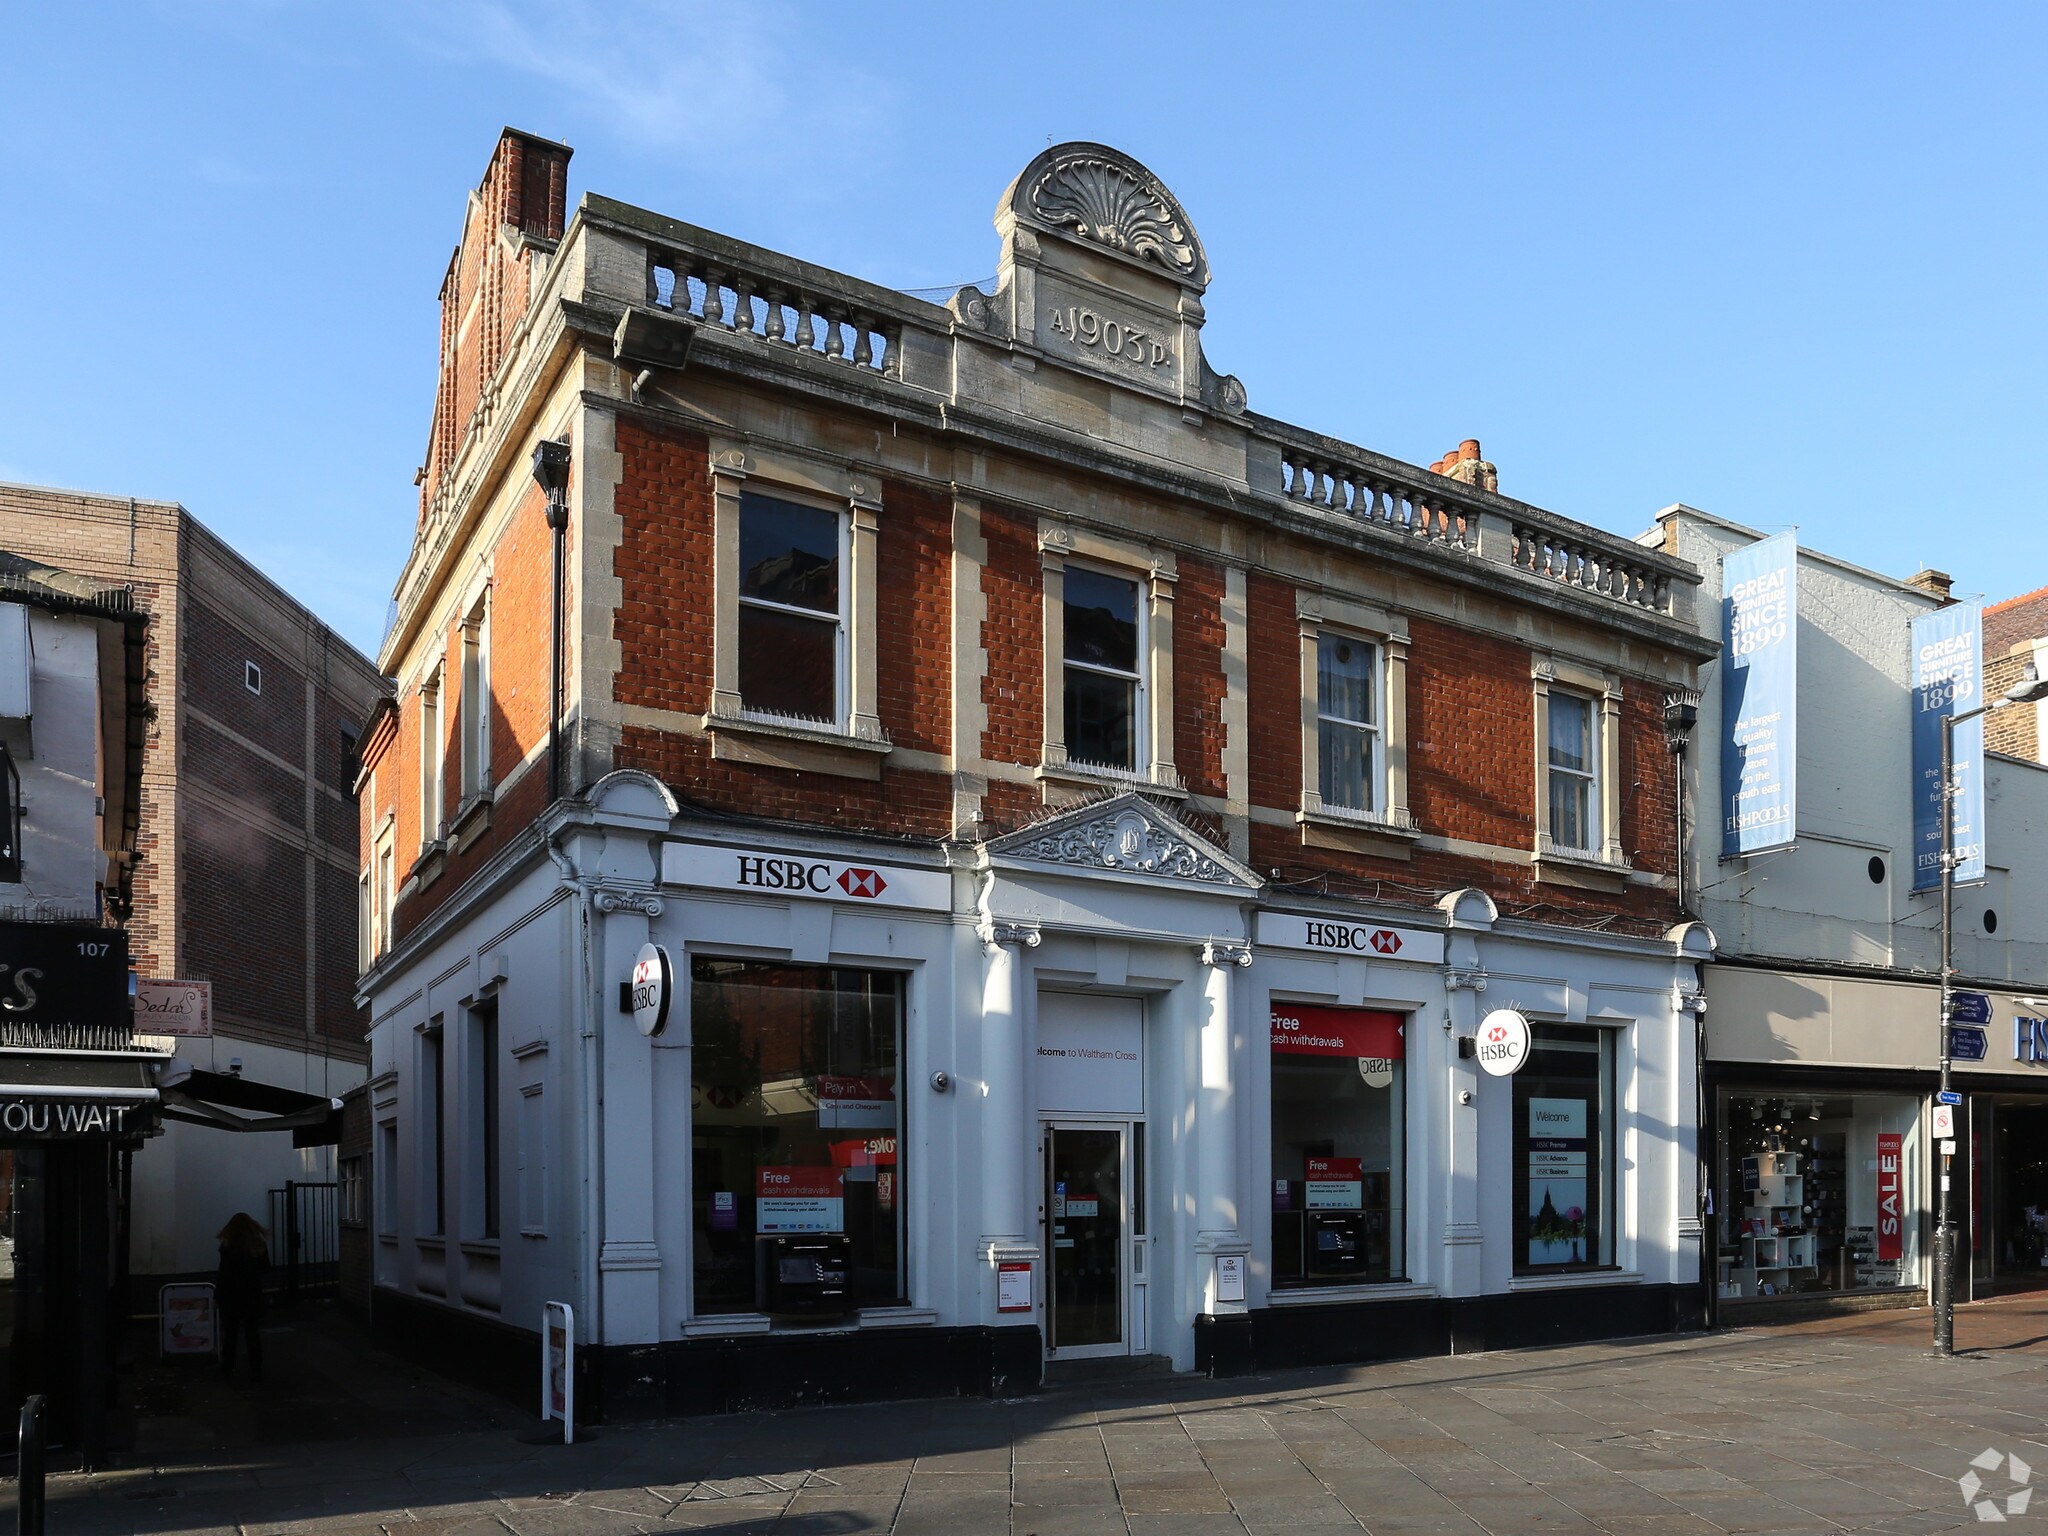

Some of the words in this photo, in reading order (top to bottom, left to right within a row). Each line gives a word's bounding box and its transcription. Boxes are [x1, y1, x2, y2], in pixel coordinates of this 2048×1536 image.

[1730, 567, 1787, 602] GREAT
[1730, 586, 1787, 616] FURNITURE
[1730, 599, 1787, 636] SINCE
[1730, 621, 1787, 659] 1899
[1920, 631, 1973, 662] GREAT
[1920, 648, 1974, 674] FURNITURE
[1920, 660, 1974, 691] SINCE
[1920, 679, 1974, 713] 1899
[1734, 720, 1748, 731] the
[1750, 711, 1782, 728] largest
[1742, 728, 1773, 745] quality
[1738, 741, 1776, 758] furniture
[1746, 756, 1768, 771] store
[1925, 768, 1939, 778] the
[1744, 774, 1753, 784] in
[1756, 771, 1770, 782] the
[1734, 786, 1760, 802] south
[1761, 782, 1782, 795] east
[1726, 804, 1790, 830] FISHPOOLS
[1952, 823, 1970, 835] east
[1918, 843, 1980, 868] FISHOOLS
[736, 855, 832, 894] HSBC
[1305, 922, 1366, 951] HSBC
[76, 942, 110, 957] 107
[1270, 1012, 1300, 1030] Free
[1290, 1034, 1344, 1048] withdrawals
[1068, 1049, 1076, 1058] to
[1078, 1048, 1113, 1059] Waltham
[1114, 1050, 1137, 1060] Cross
[1480, 1042, 1520, 1060] HSBC
[824, 1082, 844, 1095] Pay
[847, 1083, 856, 1094] in
[0, 1102, 49, 1132] OU
[56, 1104, 130, 1132] WAIT
[1536, 1112, 1570, 1122] Welcome
[1310, 1160, 1328, 1170] Free
[762, 1171, 790, 1184] Free
[763, 1186, 781, 1194] cash
[782, 1186, 830, 1194] withdrawals
[1882, 1154, 1898, 1236] SALE
